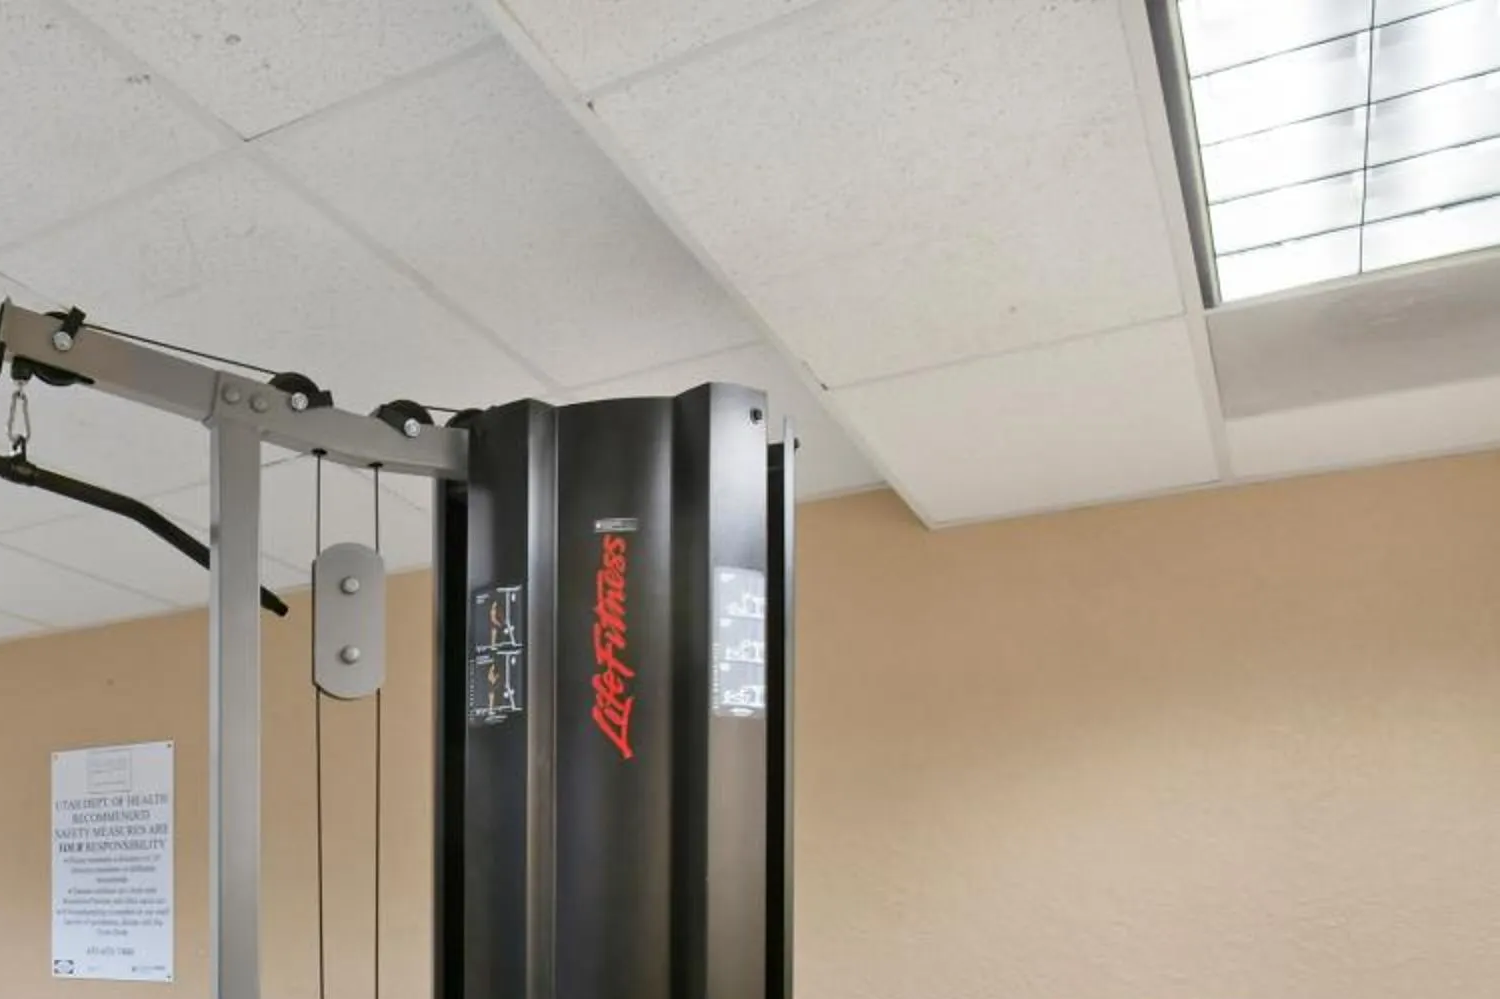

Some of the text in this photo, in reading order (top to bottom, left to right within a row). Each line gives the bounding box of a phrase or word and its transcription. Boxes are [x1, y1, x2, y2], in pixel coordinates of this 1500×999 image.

[112, 796, 122, 807] OF
[127, 793, 168, 807] HEALTH
[92, 824, 146, 837] MEASURES
[149, 823, 168, 835] ARE
